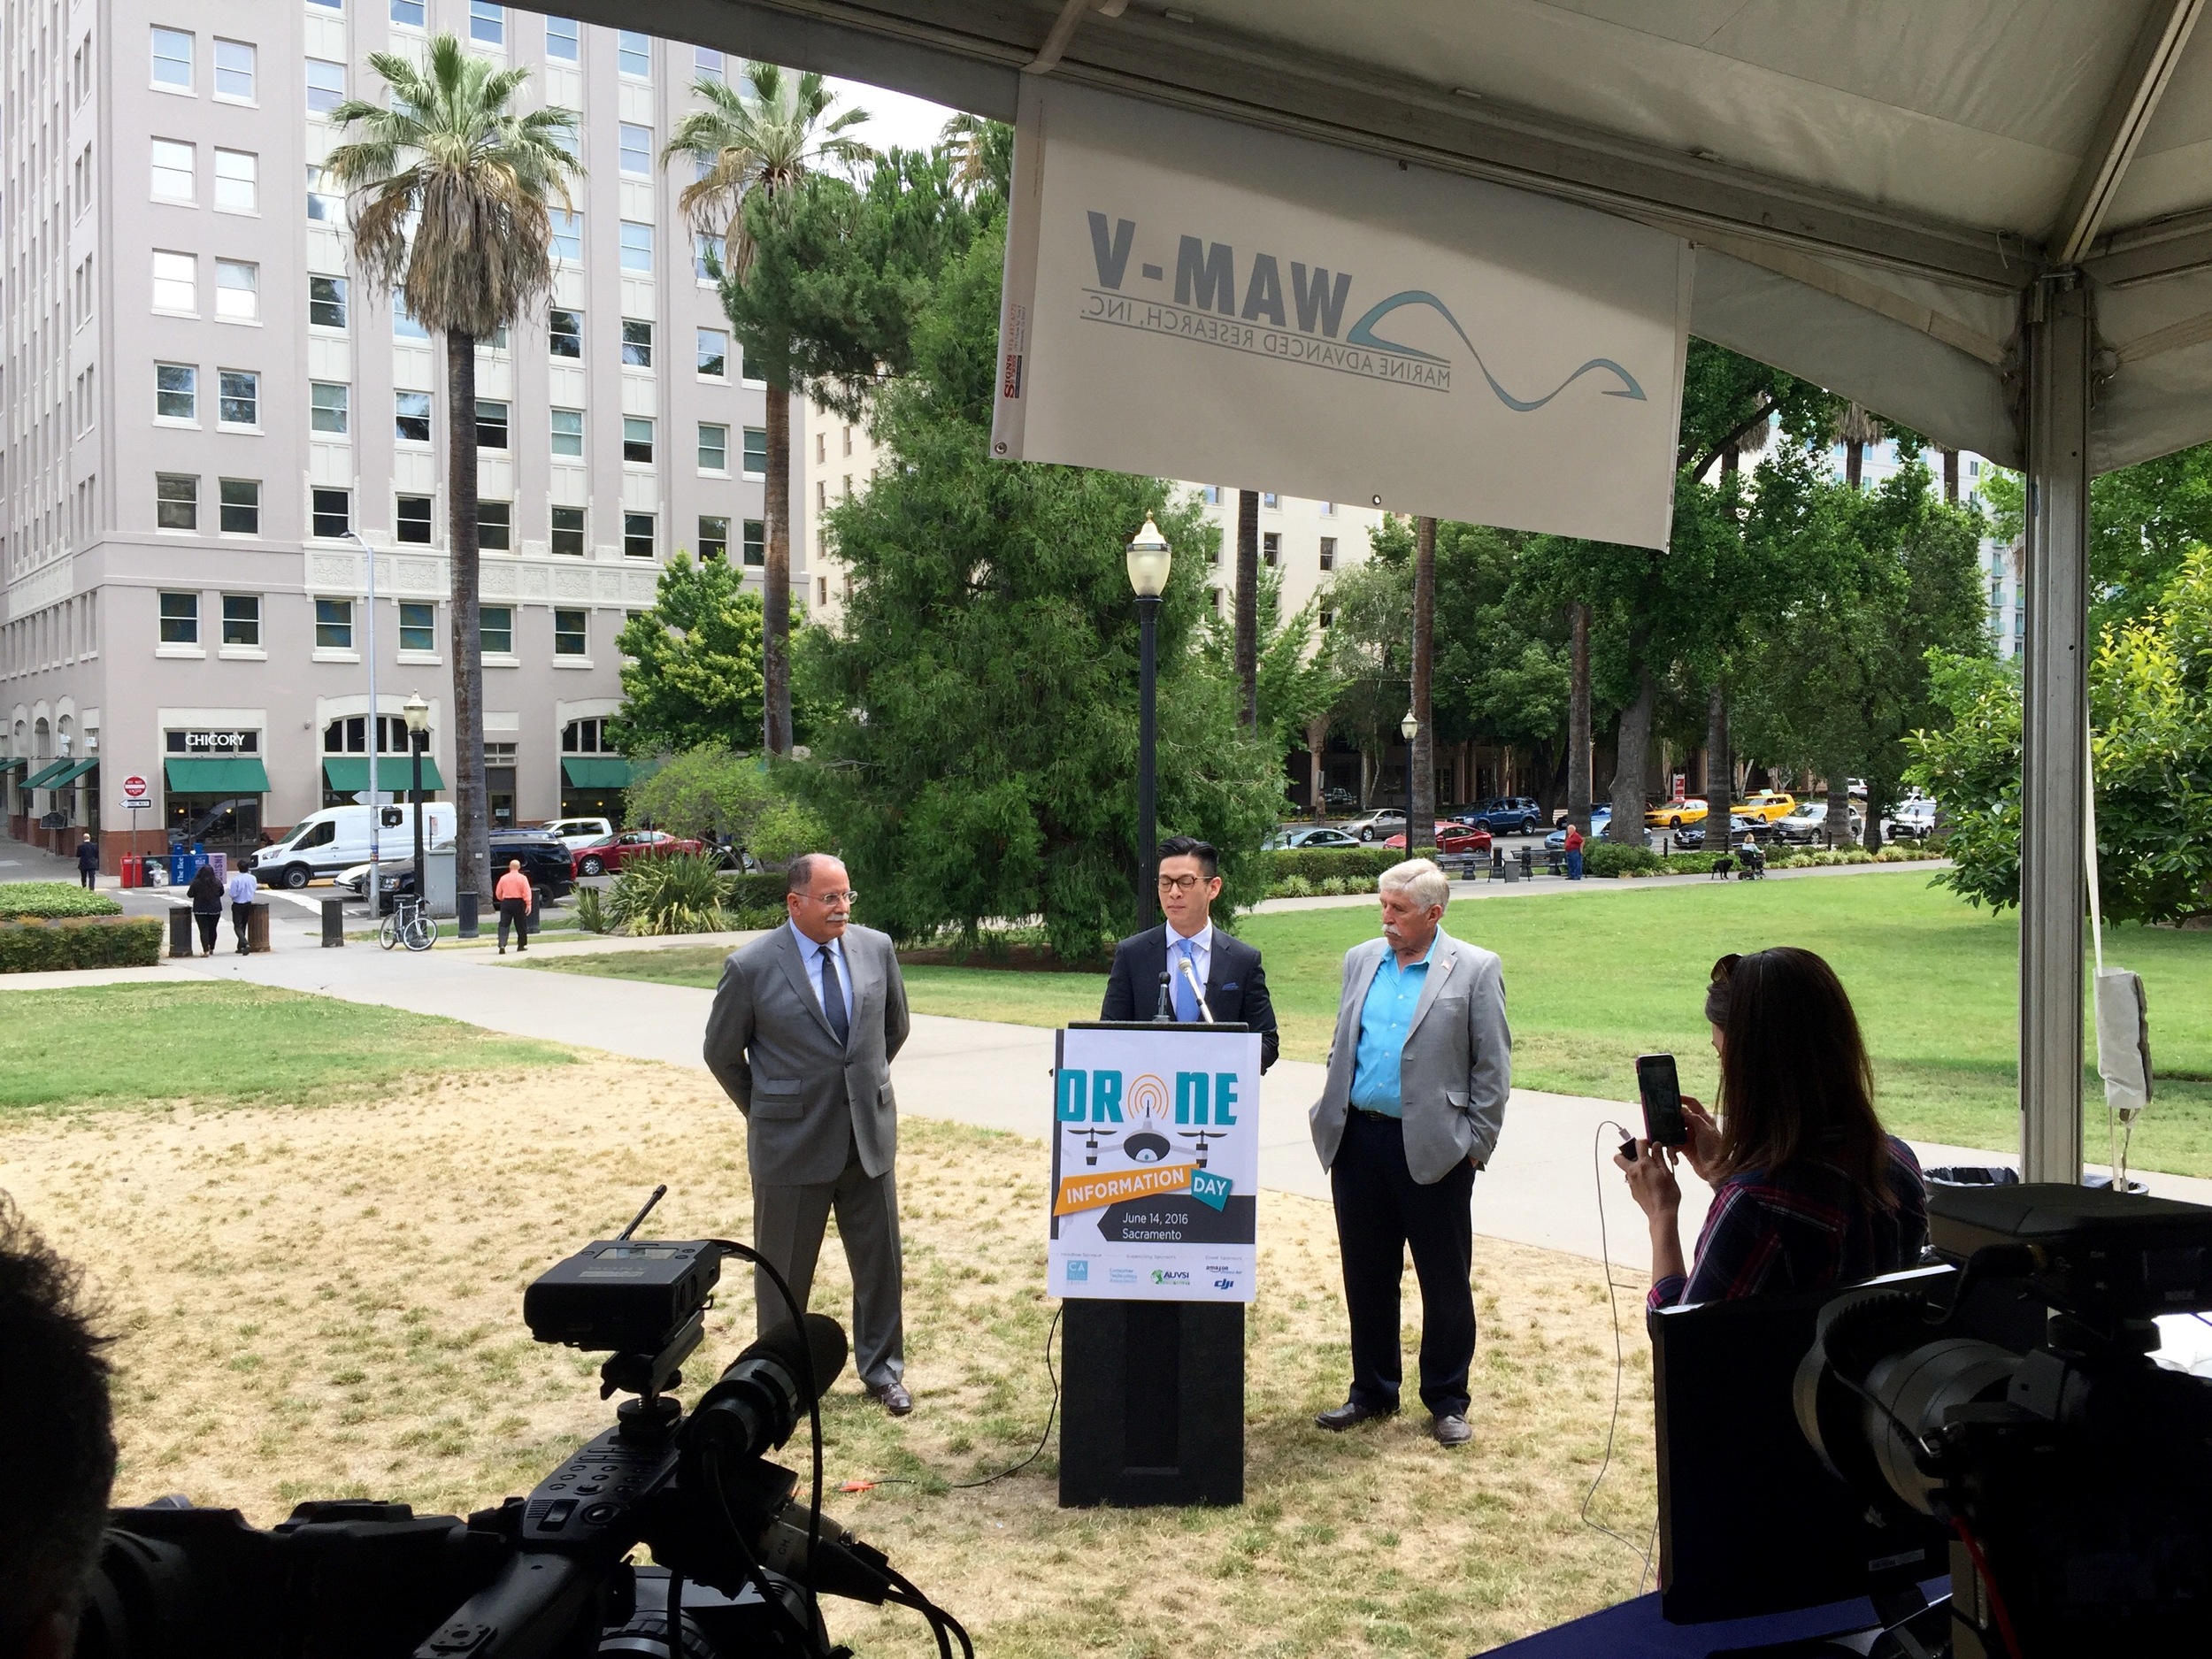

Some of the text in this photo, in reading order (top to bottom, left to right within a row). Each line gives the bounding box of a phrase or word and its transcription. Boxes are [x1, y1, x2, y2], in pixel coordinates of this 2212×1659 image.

[185, 734, 245, 746] CHICORY
[1066, 1168, 1185, 1204] INFORMATION
[1194, 1177, 1227, 1196] DAY
[1122, 1212, 1188, 1226] June 14, 2016
[1122, 1228, 1182, 1240] Sacramento
[1069, 1262, 1085, 1271] CA
